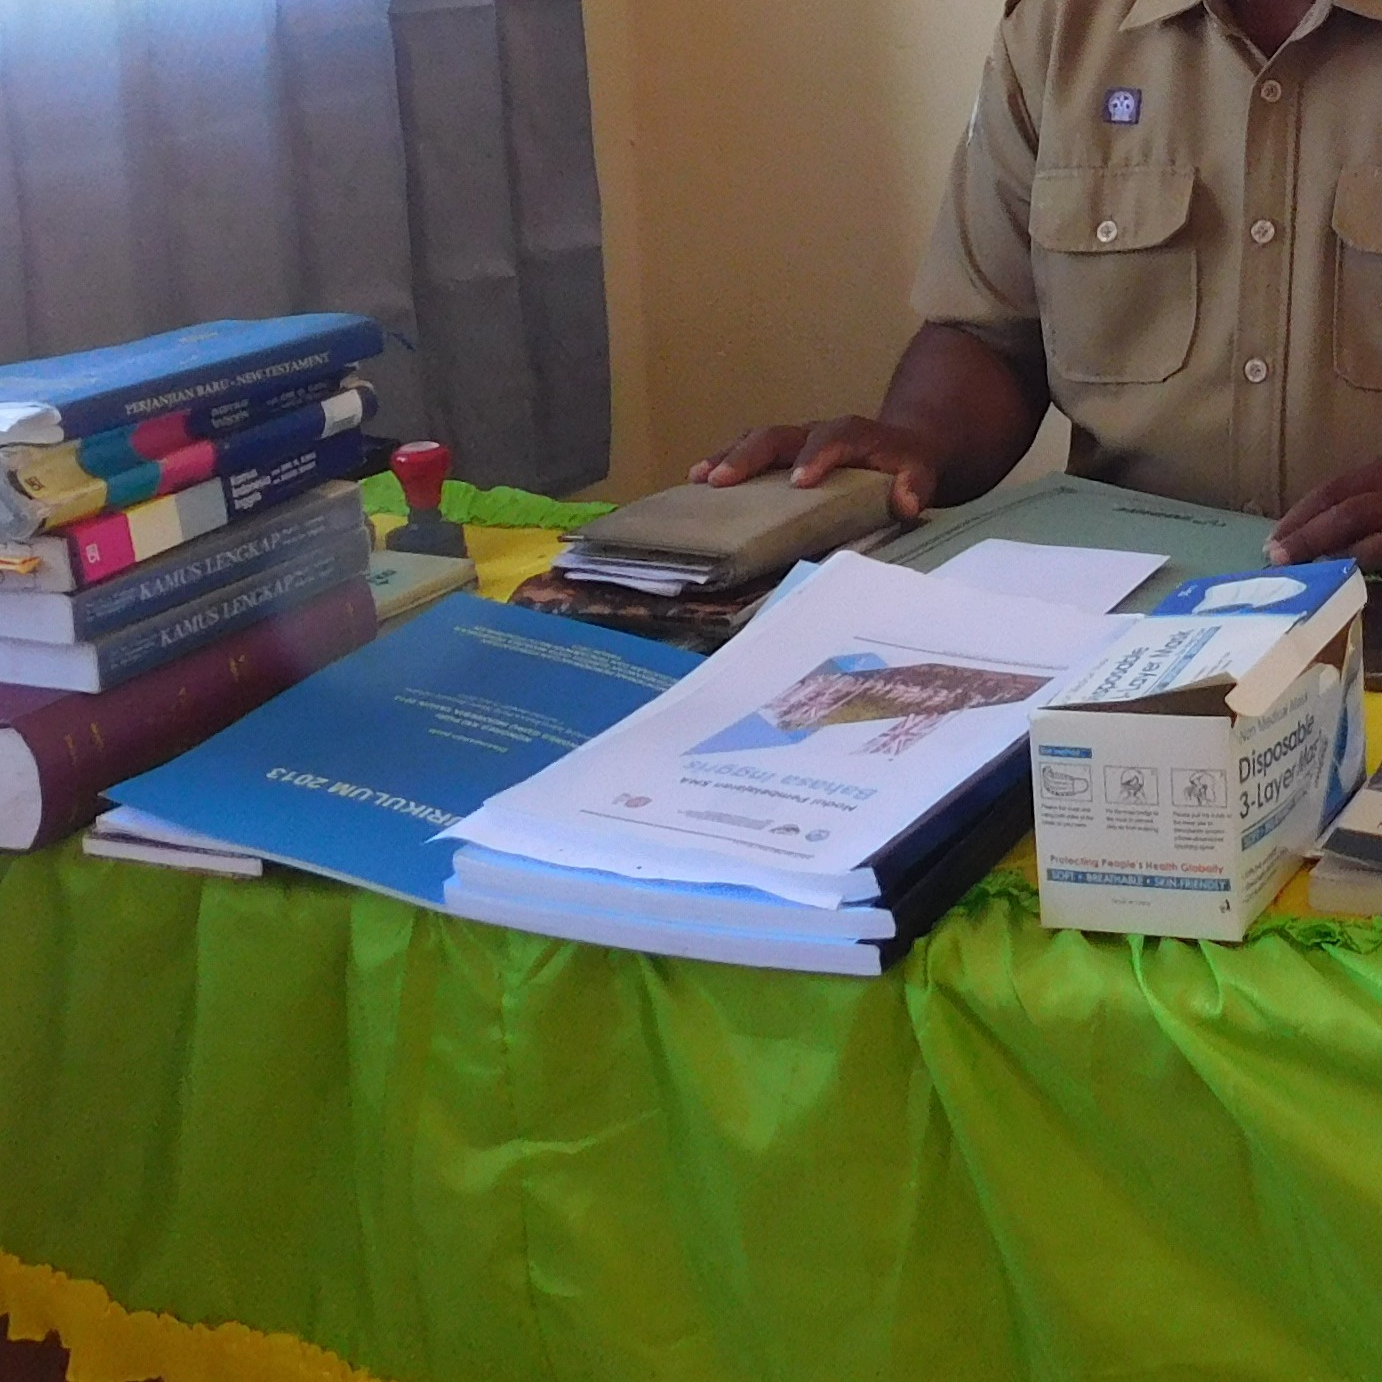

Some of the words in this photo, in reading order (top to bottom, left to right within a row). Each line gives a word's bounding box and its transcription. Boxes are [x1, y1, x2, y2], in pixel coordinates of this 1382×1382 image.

[124, 386, 197, 416] PERJANJIAN
[197, 376, 232, 398] BARU
[265, 351, 330, 381] TESTAMENT
[138, 561, 203, 601] KAMUS
[200, 531, 282, 576] LENGKAP
[159, 607, 220, 648] KAMUS
[220, 573, 295, 619] LENGKAP
[1238, 713, 1315, 784] Disposable
[265, 767, 329, 789] 2013
[679, 776, 713, 788] SMA
[682, 761, 777, 784] Inggris
[713, 782, 810, 804] Pembelajaran
[780, 774, 878, 801] Bahasa
[1239, 762, 1297, 819] 3-Layer
[809, 798, 858, 813] Modul
[1050, 854, 1099, 868] Protecting
[1101, 858, 1144, 871] People's
[1145, 860, 1178, 872] Health
[1180, 863, 1225, 875] Globally
[1051, 870, 1075, 881] SOFT
[1086, 873, 1144, 886] BREATHABLE
